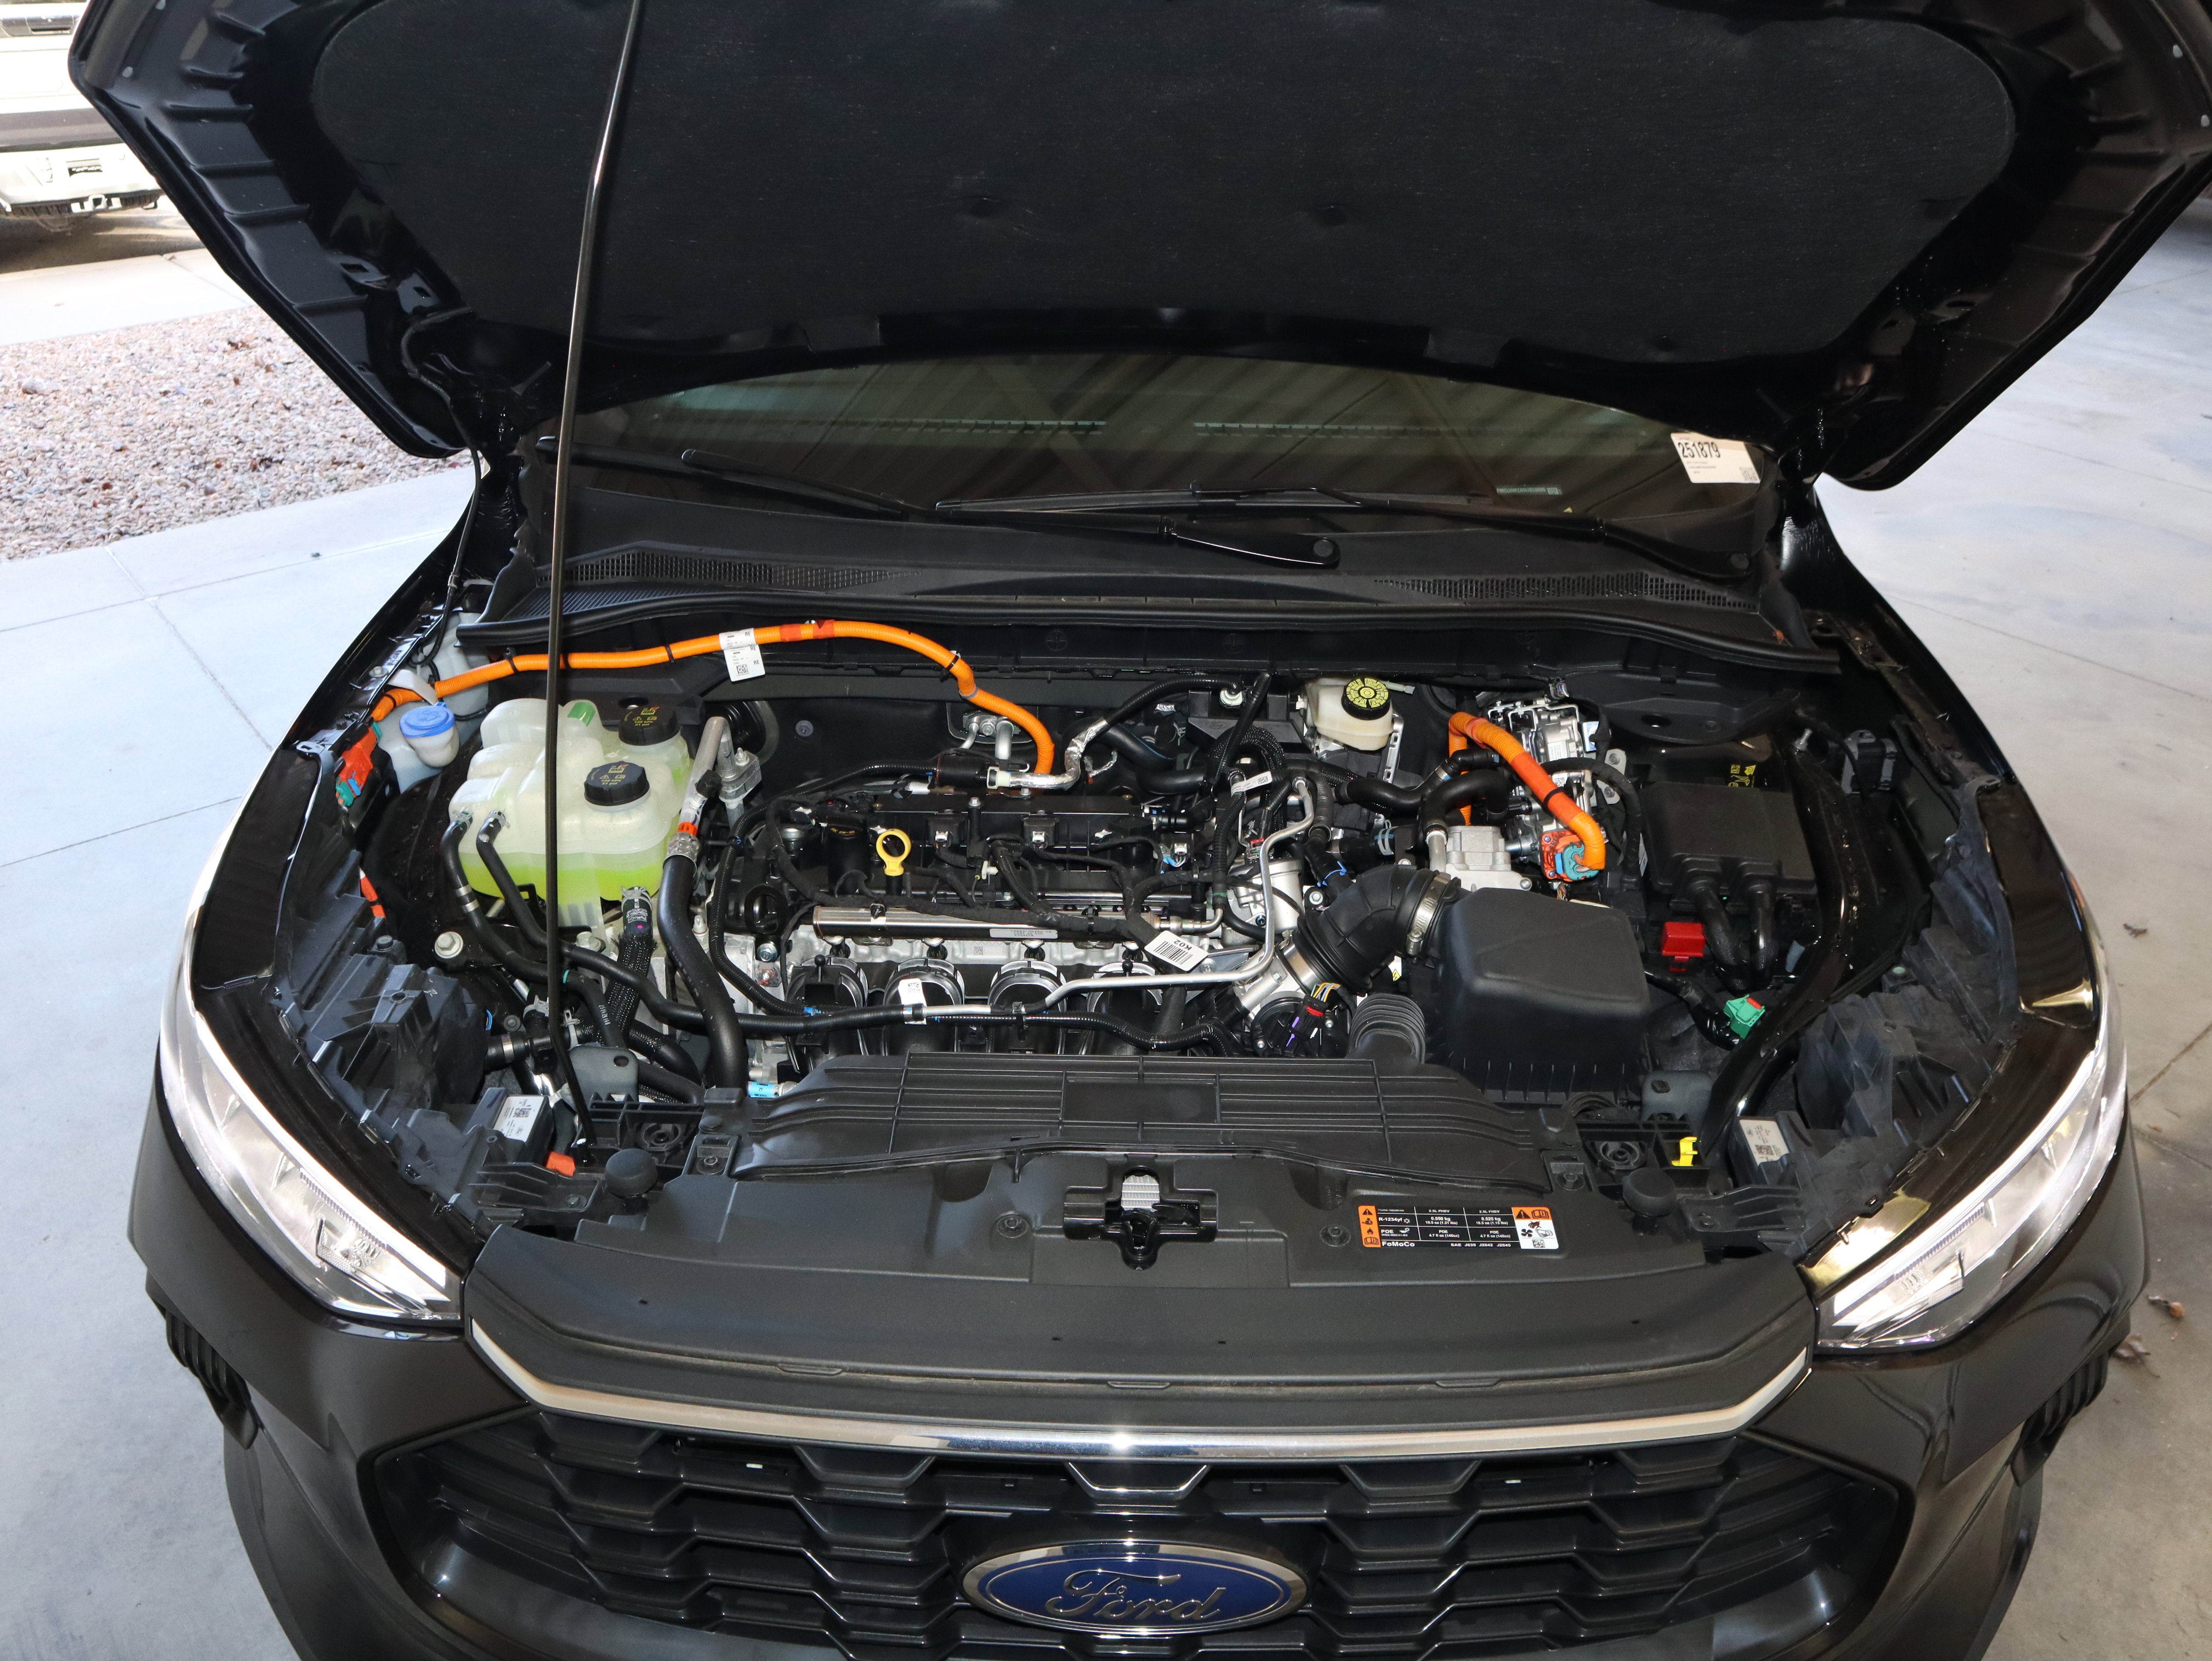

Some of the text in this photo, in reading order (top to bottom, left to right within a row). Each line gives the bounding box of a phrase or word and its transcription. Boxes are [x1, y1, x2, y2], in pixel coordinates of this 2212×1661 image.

[1678, 441, 1720, 458] 251879
[1174, 939, 1192, 951] K02
[1045, 1570, 1226, 1619] Ford
